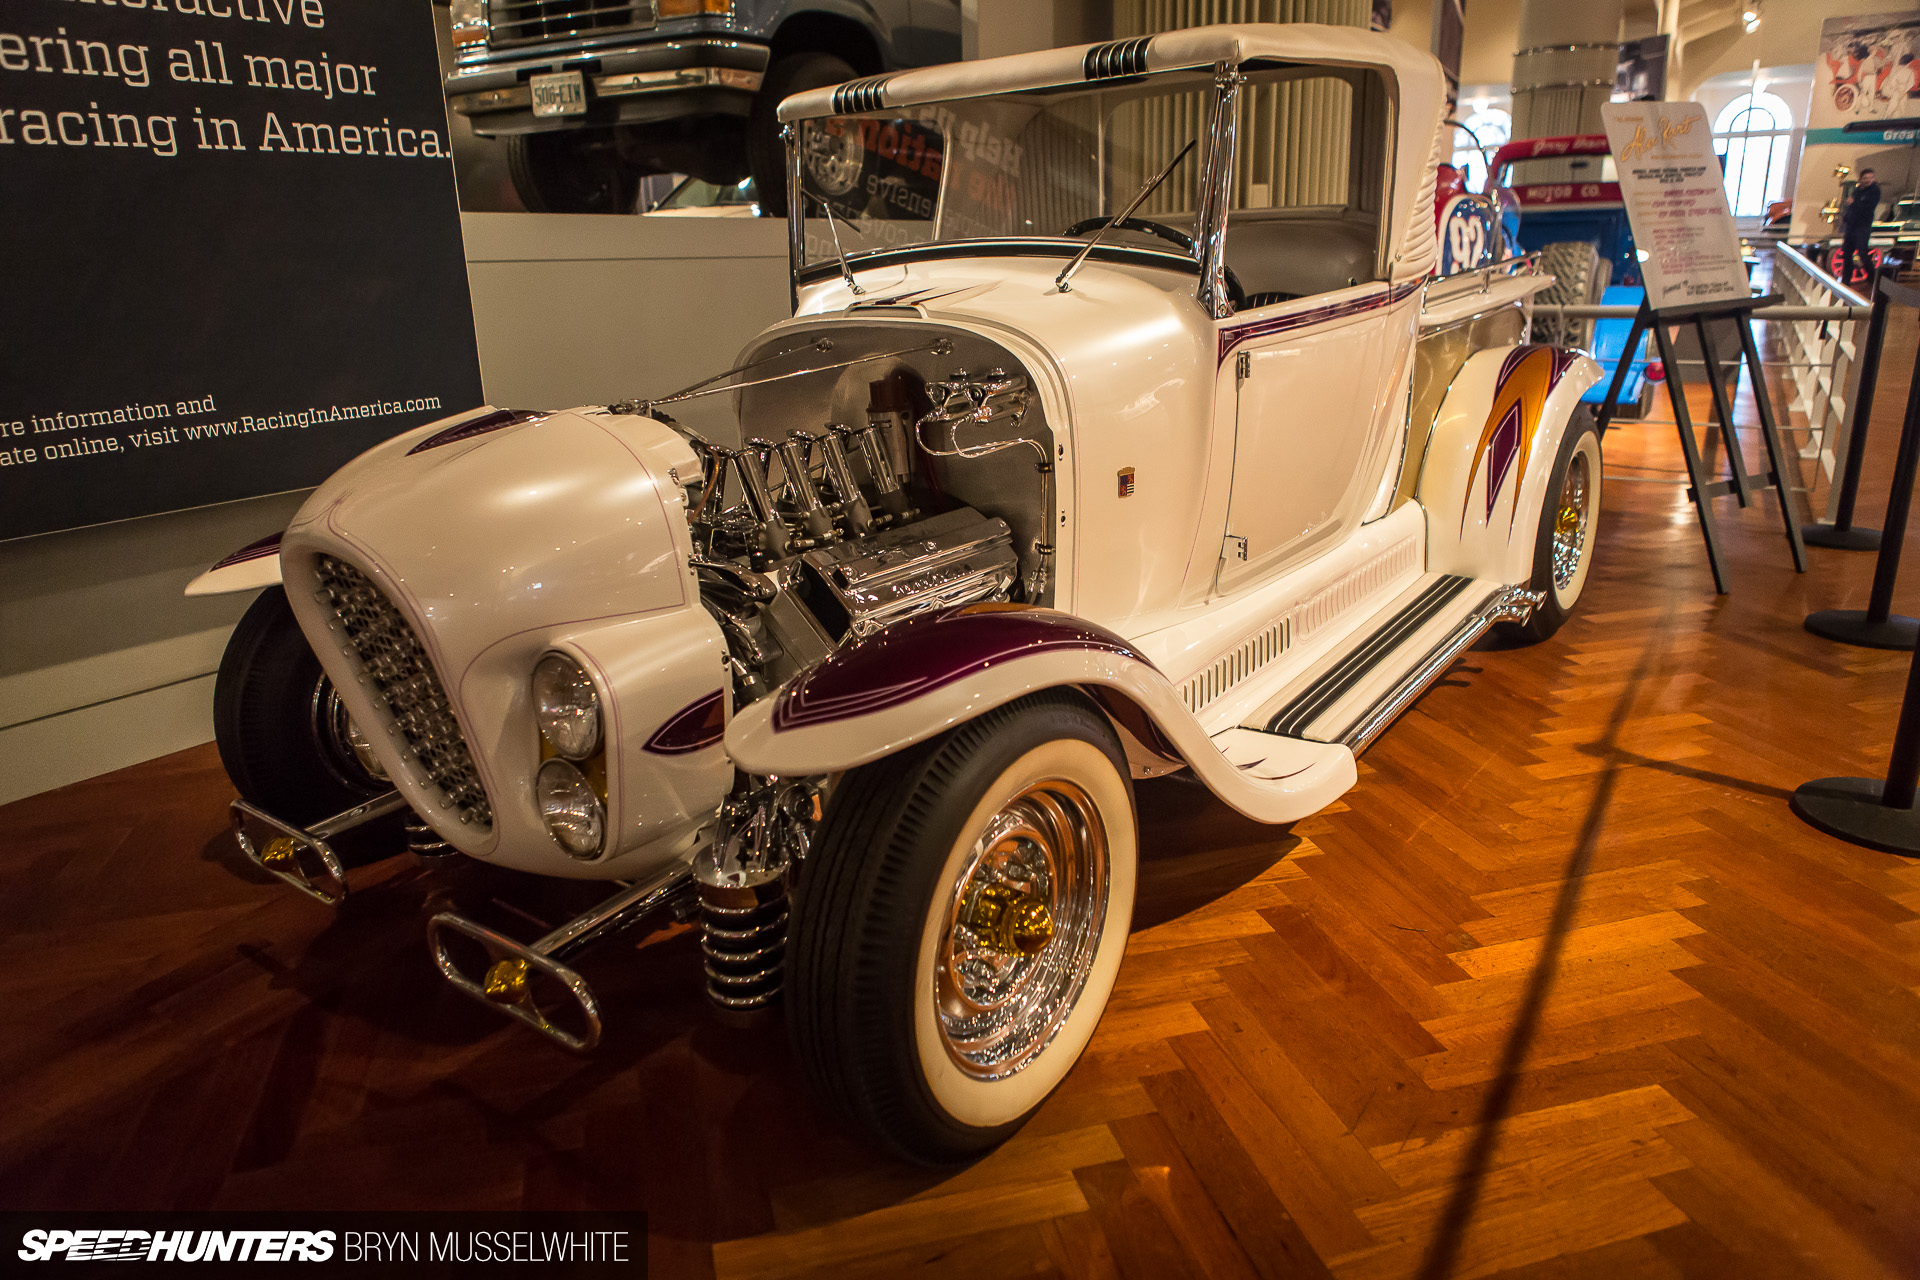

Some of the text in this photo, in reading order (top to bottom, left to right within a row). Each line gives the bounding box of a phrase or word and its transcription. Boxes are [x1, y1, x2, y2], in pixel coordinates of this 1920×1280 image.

[168, 40, 233, 85] all
[243, 52, 377, 99] major
[193, 107, 246, 150] in
[259, 112, 451, 158] America.
[31, 402, 171, 433] information
[176, 394, 217, 415] and
[44, 437, 125, 461] online,
[128, 426, 180, 448] visit
[184, 396, 442, 441] www.RacingInAmerica.com
